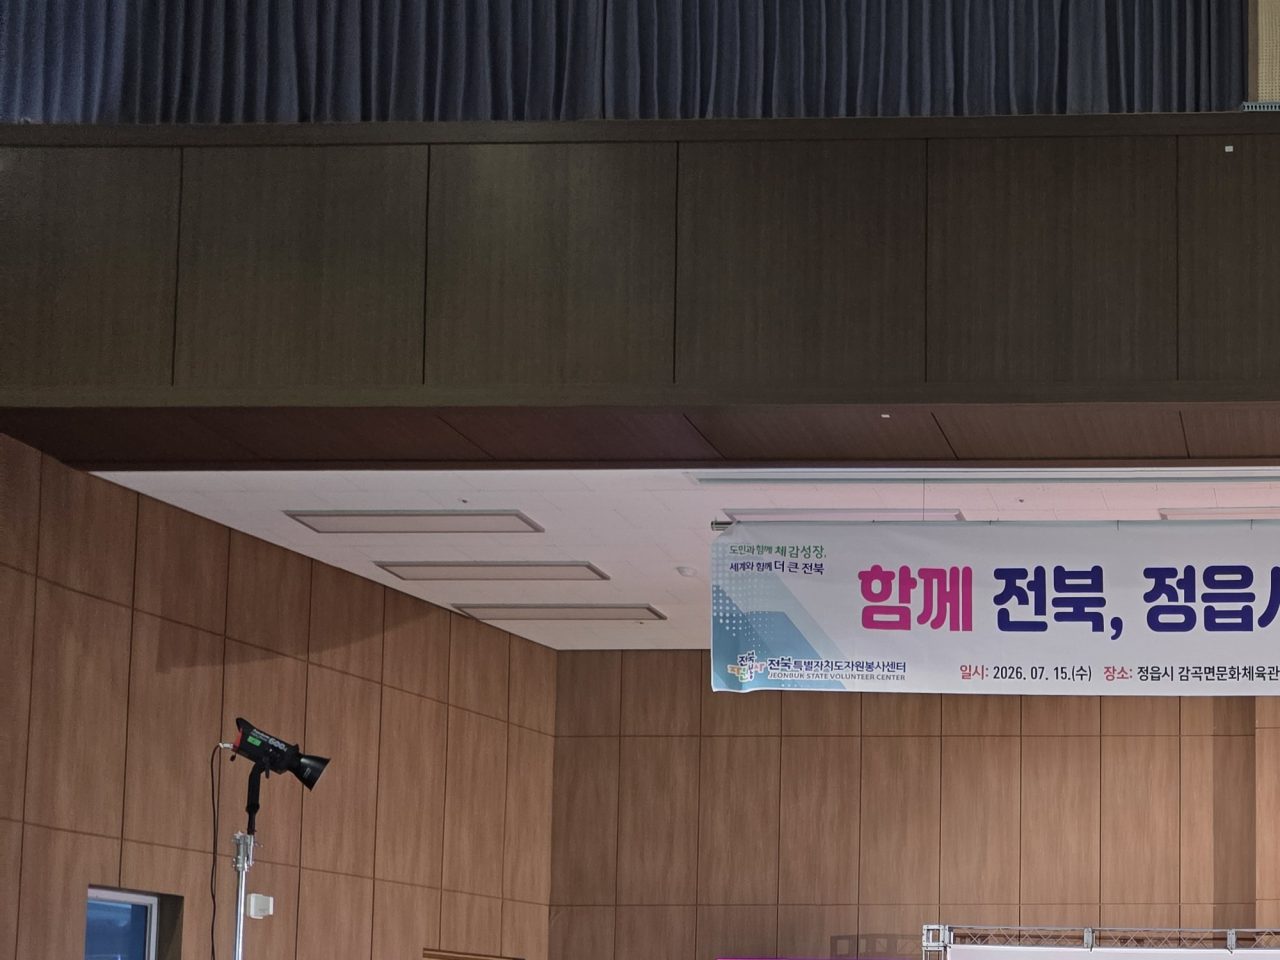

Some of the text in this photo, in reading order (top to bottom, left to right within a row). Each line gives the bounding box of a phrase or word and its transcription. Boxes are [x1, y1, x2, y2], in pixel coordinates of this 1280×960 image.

[756, 545, 773, 554] 함께
[729, 560, 825, 575] 세계와 함께 더 큰 전북
[858, 564, 974, 632] 함께
[993, 565, 1123, 640] 전북,
[768, 657, 906, 672] 전북특별자치도자원봉사센터
[769, 672, 805, 680] JEONBUK
[830, 673, 875, 681] VOLUNTEER
[960, 664, 989, 680] 일시:
[993, 666, 1026, 681] 2026.
[1030, 666, 1049, 681] 07.
[1054, 665, 1092, 682] 15.(수)
[1104, 666, 1133, 680] 장소:
[1137, 665, 1174, 681] 정읍시
[1178, 665, 1280, 681] 감곡면문화체육관
